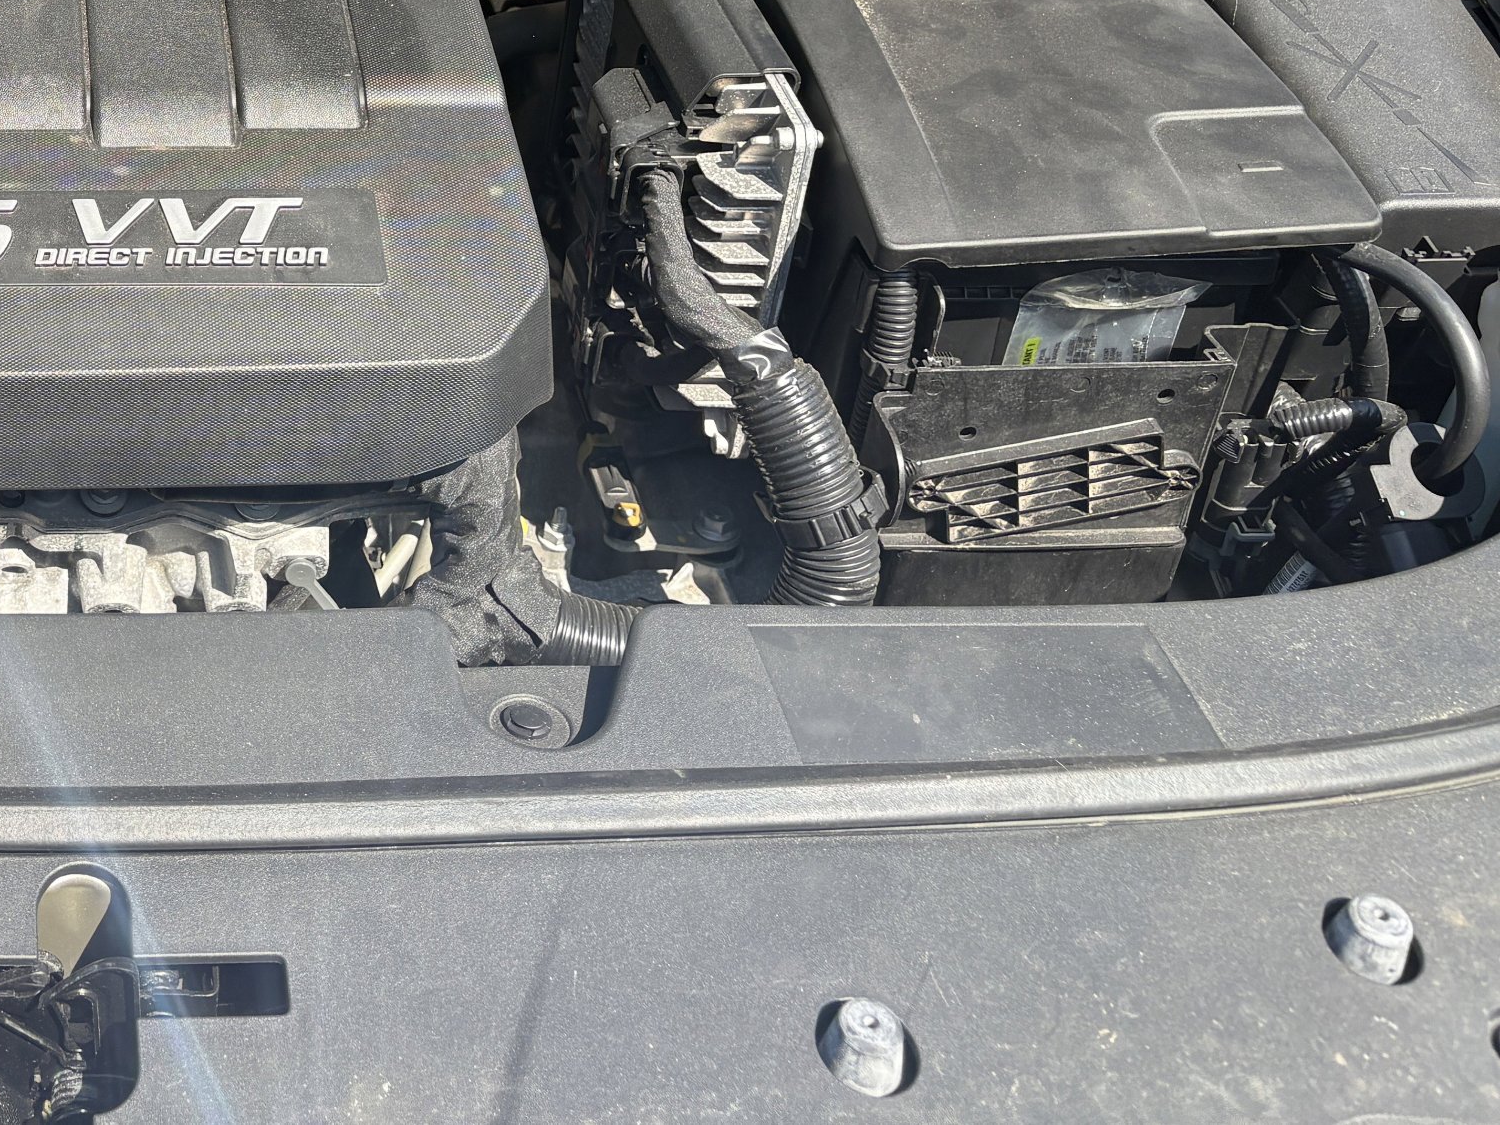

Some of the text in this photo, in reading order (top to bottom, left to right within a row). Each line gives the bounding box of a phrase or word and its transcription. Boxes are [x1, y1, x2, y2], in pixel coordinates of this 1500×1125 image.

[71, 197, 304, 245] VVT
[34, 245, 329, 268] DIRECT INJECTION
